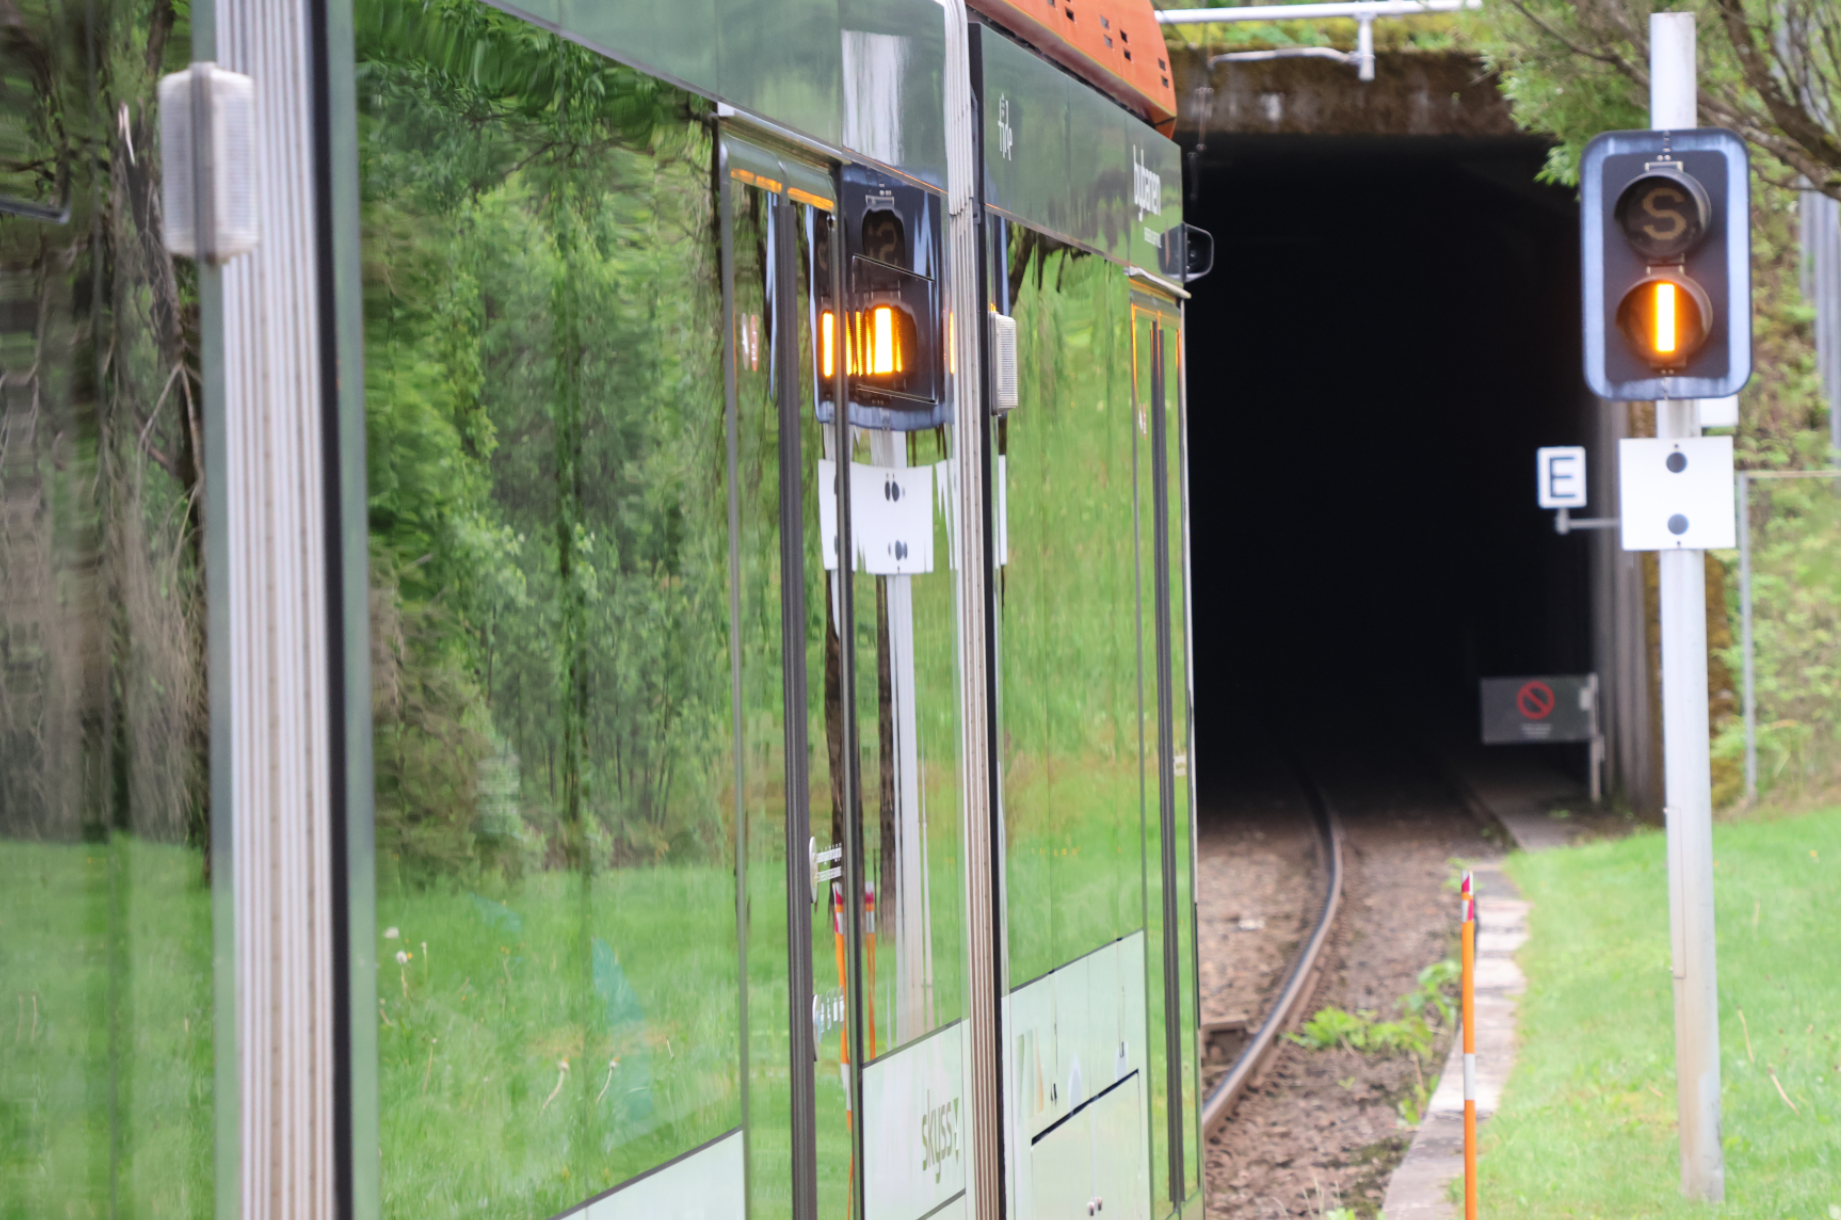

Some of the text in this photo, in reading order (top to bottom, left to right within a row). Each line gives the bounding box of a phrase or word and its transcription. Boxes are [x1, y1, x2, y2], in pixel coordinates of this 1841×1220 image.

[1642, 187, 1687, 240] S
[1549, 456, 1576, 498] E
[922, 1088, 952, 1184] skyss
